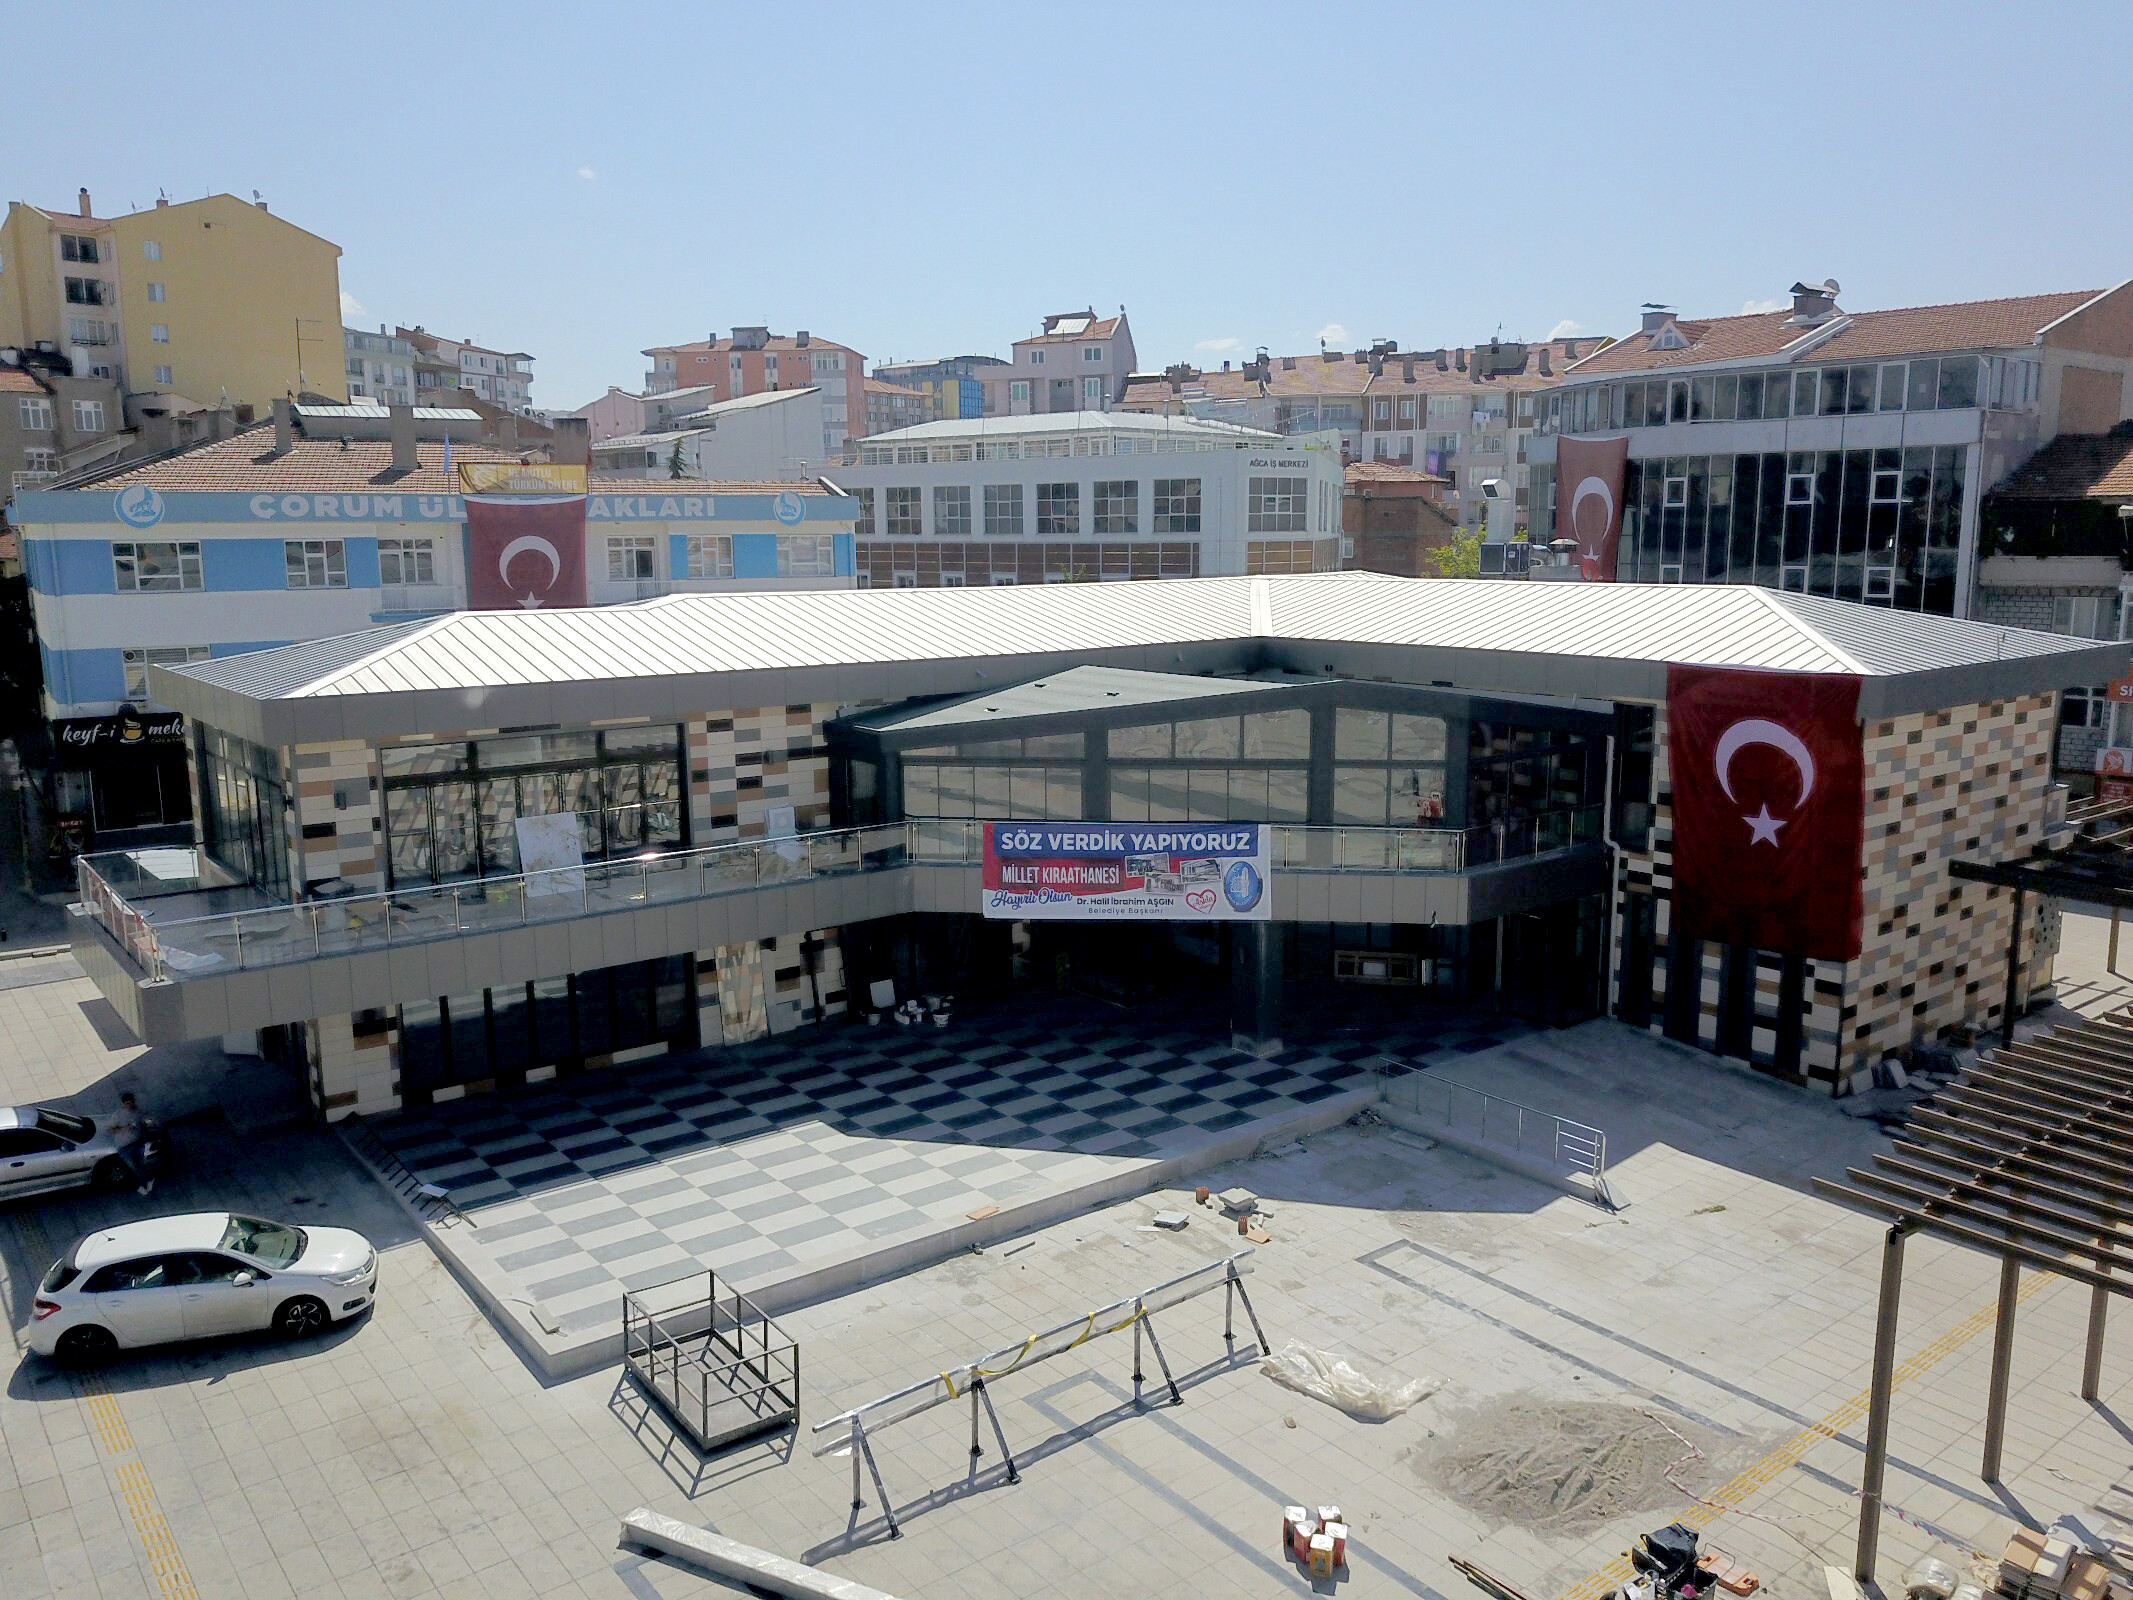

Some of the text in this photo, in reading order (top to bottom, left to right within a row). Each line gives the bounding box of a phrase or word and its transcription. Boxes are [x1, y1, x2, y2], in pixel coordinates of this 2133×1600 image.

[1278, 459, 1309, 468] MERKEZİ
[250, 494, 715, 519] ÇORUM ÜL AKLARI
[1001, 829, 1251, 851] SÖZ VERDİK YAPIYORUZ
[1002, 863, 1120, 884] MİLLET KIRAATHANESİ
[990, 886, 1072, 911] Hayırlı Olsun
[1090, 897, 1110, 905] Halil
[1111, 897, 1145, 906] İbrahim
[1147, 898, 1174, 908] AŞGIN
[1088, 907, 1163, 915] Belediye Başkanı
